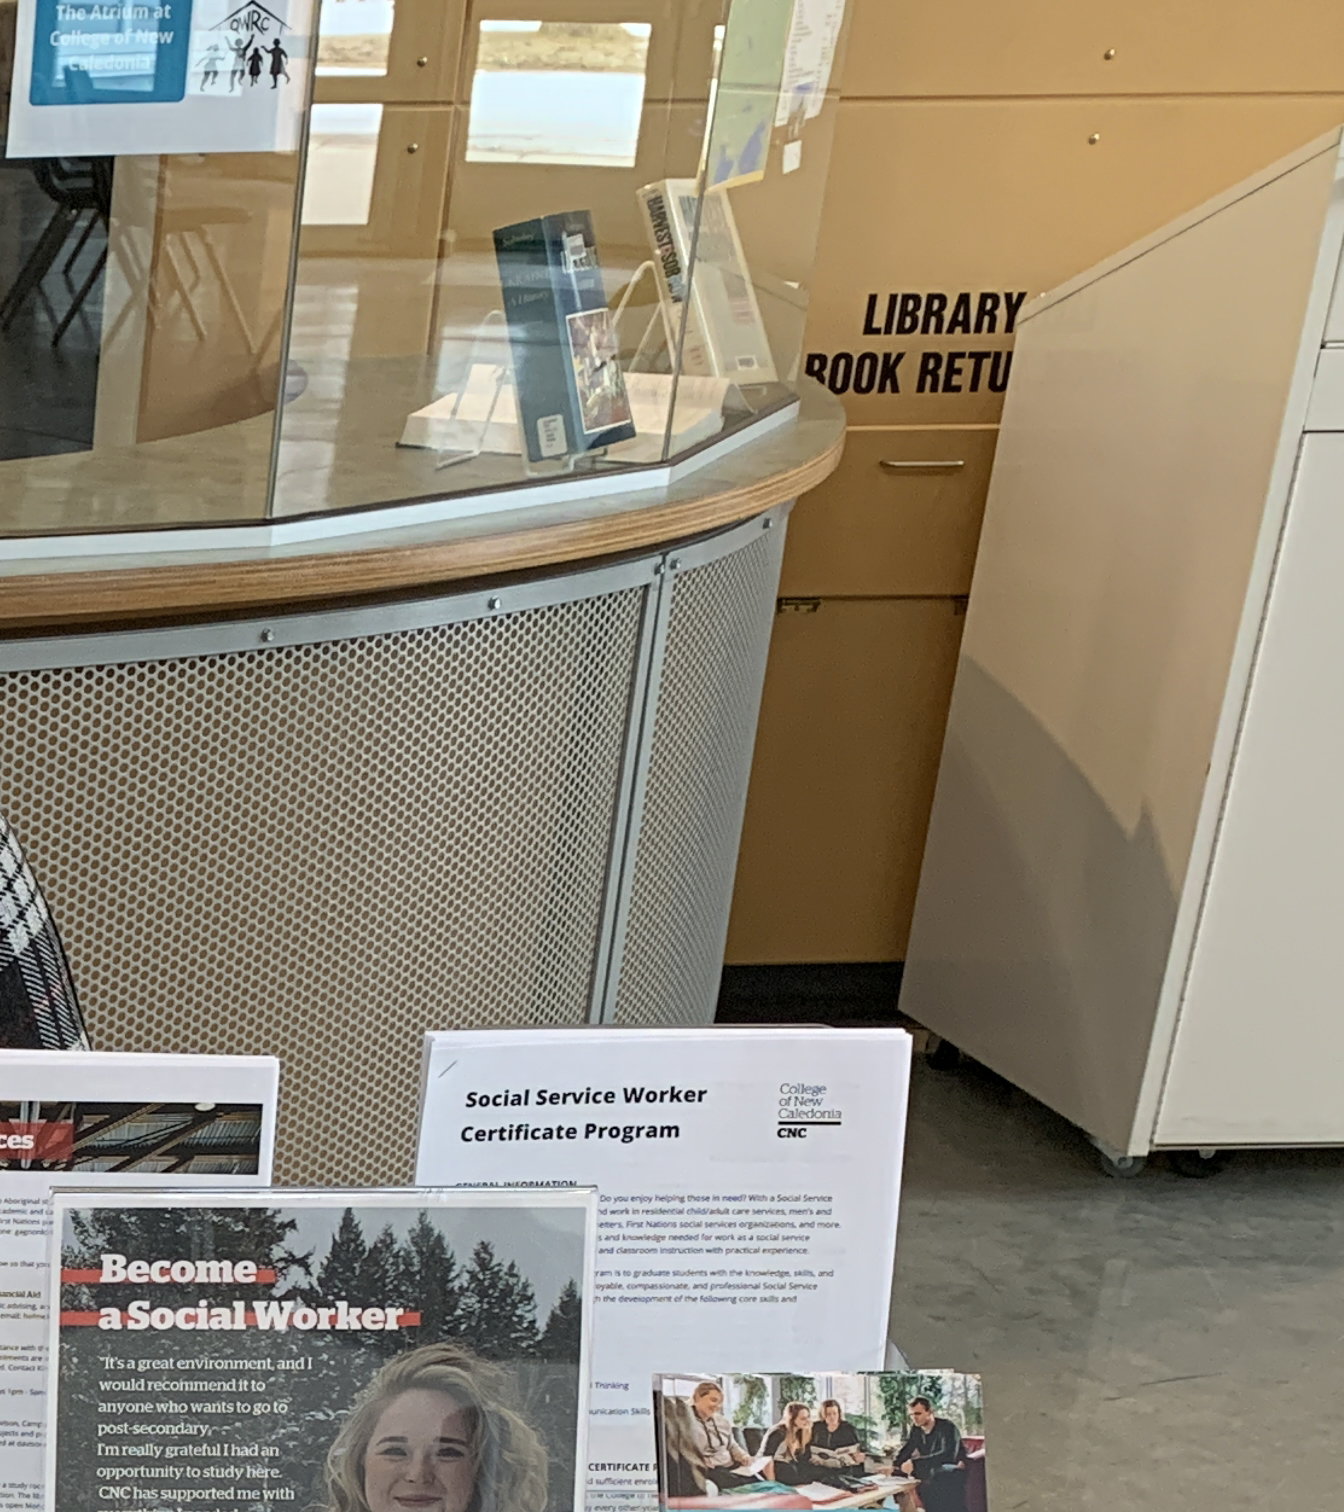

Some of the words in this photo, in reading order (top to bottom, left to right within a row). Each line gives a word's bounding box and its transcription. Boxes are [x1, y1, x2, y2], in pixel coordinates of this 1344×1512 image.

[57, 5, 85, 20] The
[90, 5, 148, 19] Atrium
[154, 5, 171, 19] at
[50, 30, 109, 47] College
[115, 30, 131, 45] of
[136, 30, 174, 45] New
[68, 56, 150, 70] Caledonia
[863, 292, 1027, 335] LIBRARY
[805, 352, 906, 395] BOOK
[466, 1089, 529, 1107] Social
[536, 1087, 616, 1106] Service
[622, 1086, 708, 1104] Worker
[779, 1083, 826, 1096] College
[779, 1095, 790, 1107] of
[793, 1096, 822, 1107] New
[778, 1108, 841, 1120] Caledonia
[461, 1124, 577, 1143] Certificate
[584, 1122, 679, 1144] Program
[777, 1128, 807, 1138] CNC
[100, 1253, 257, 1285] Become
[99, 1308, 121, 1330] a
[128, 1300, 247, 1331] Social
[253, 1301, 405, 1331] Worker
[127, 1360, 135, 1369] a
[137, 1358, 174, 1372] great
[177, 1358, 274, 1371] environment,
[277, 1358, 304, 1370] and
[99, 1379, 144, 1391] would
[147, 1379, 235, 1391] recommend
[239, 1379, 248, 1391] it
[251, 1380, 265, 1391] to
[588, 1463, 649, 1472] CERTIFICATE
